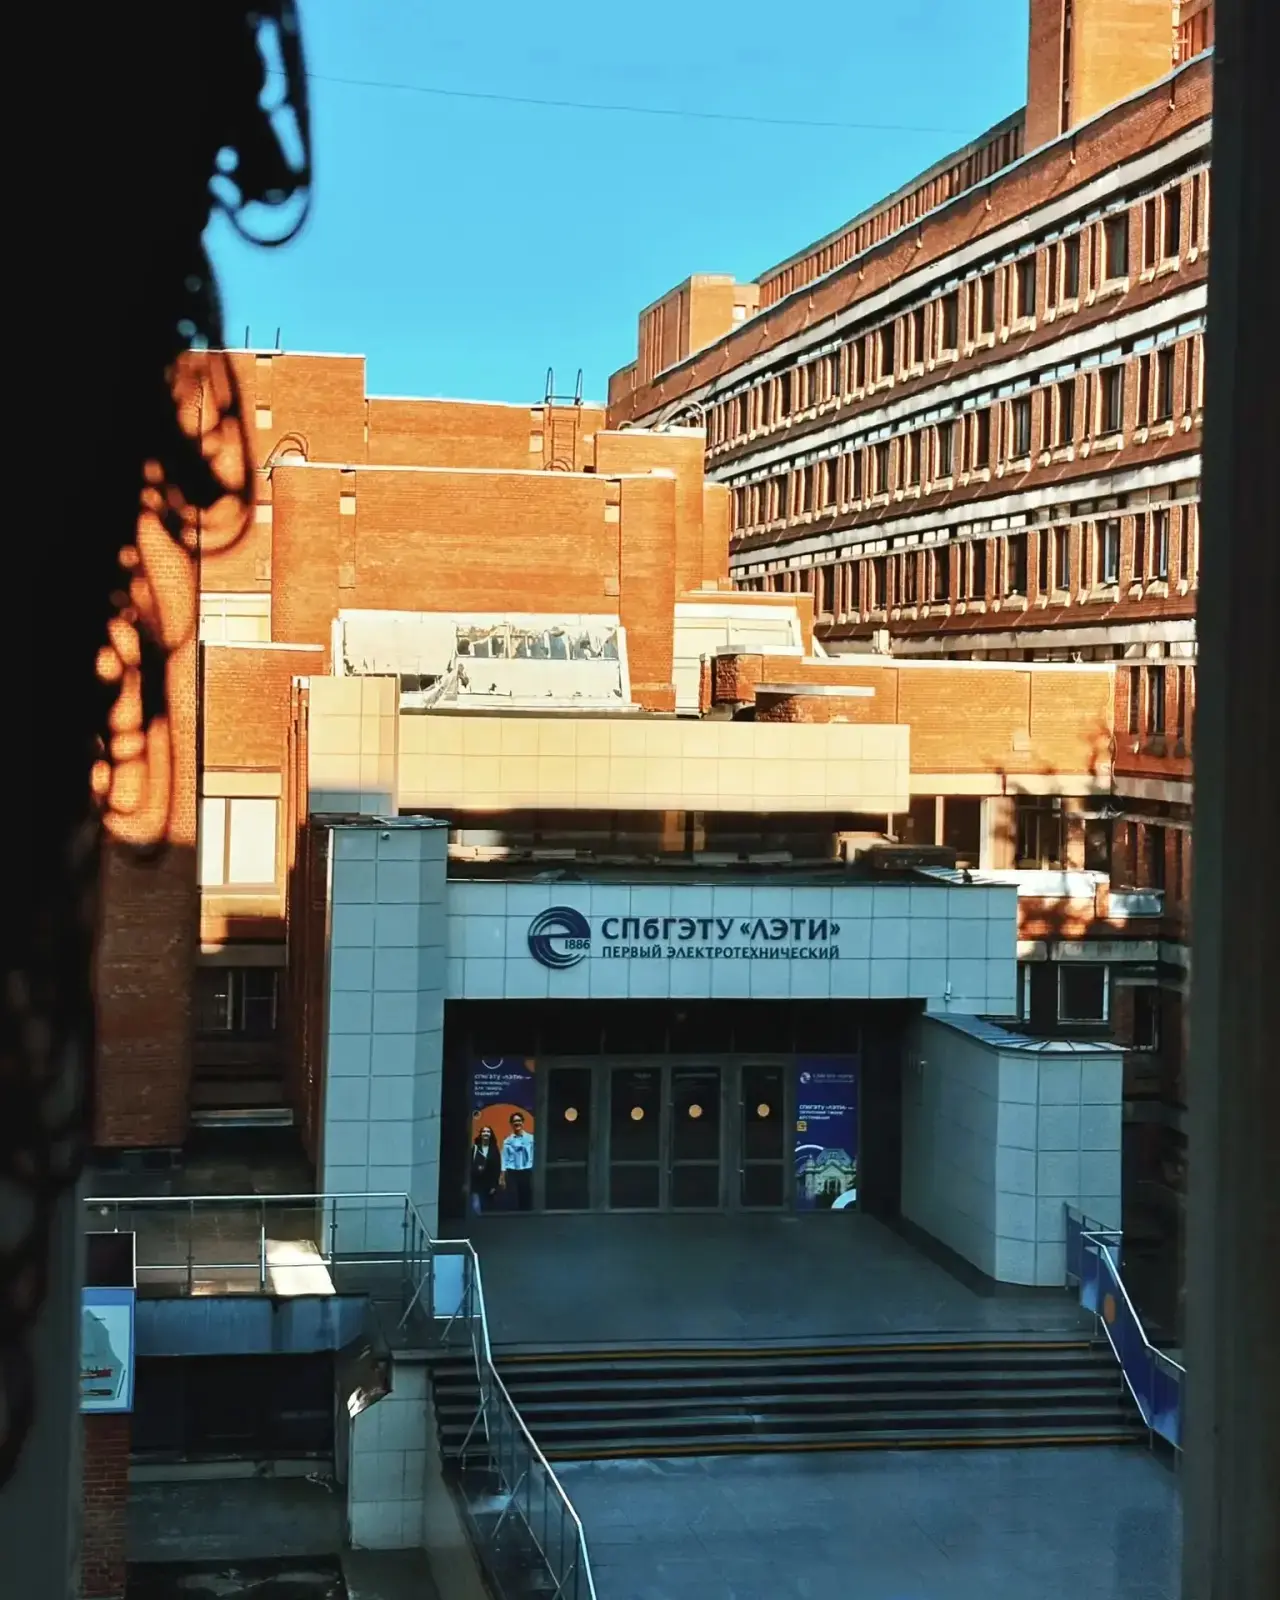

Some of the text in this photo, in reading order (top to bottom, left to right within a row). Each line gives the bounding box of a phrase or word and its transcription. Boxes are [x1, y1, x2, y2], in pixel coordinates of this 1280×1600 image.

[601, 917, 841, 941] СПбГЭТУ «ЛЭТИ»
[564, 939, 591, 950] 1886
[602, 944, 840, 960] ПЕРВЫЙ ЭЛЕКТРОТЕХНИЧЕСКИЙ
